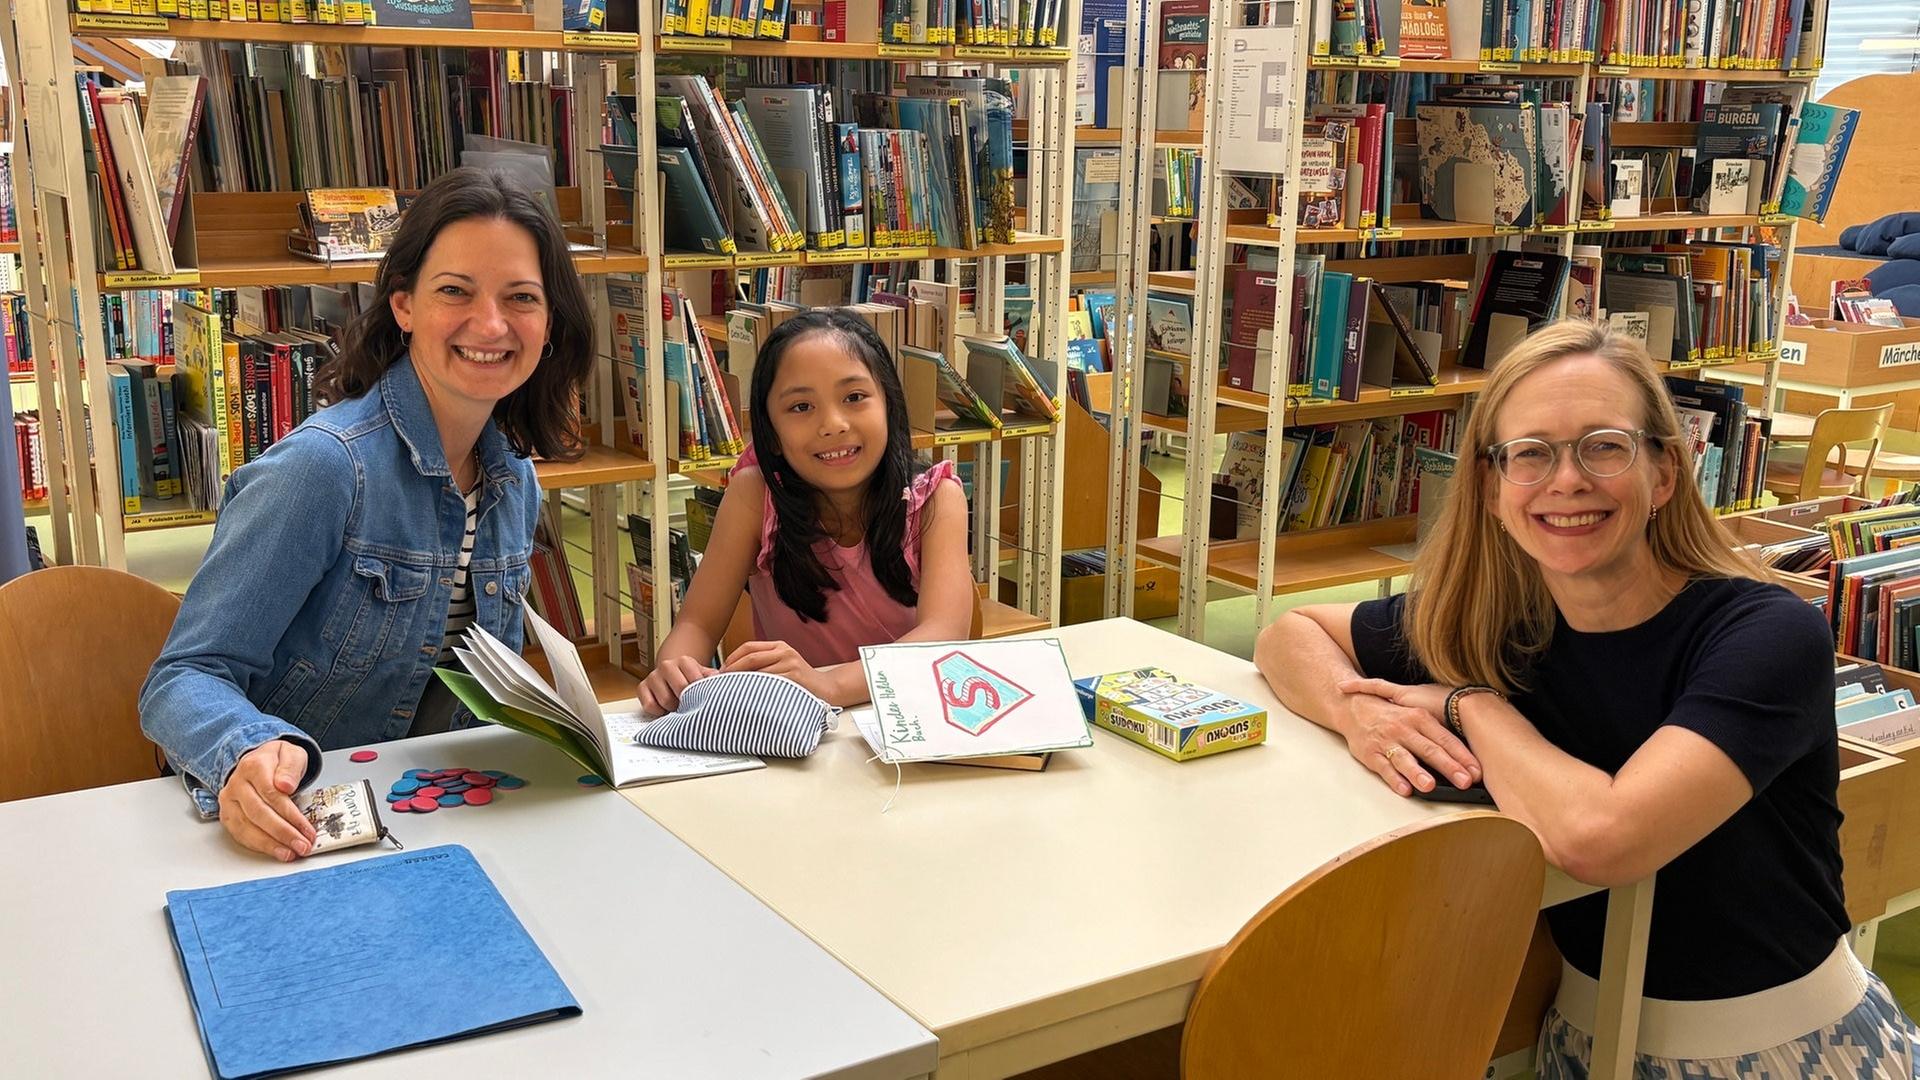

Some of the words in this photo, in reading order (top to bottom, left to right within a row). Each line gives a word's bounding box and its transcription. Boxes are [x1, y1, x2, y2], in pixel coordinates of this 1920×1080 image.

[1717, 112, 1761, 125] BURGEN
[823, 169, 831, 193] UNSERE
[831, 168, 839, 192] UNSERE
[1781, 347, 1801, 361] en
[244, 354, 255, 389] STORIES
[122, 385, 130, 404] euch!
[229, 392, 241, 415] KIDS
[244, 394, 259, 419] BOYS
[124, 405, 133, 439] Informiert
[875, 670, 896, 699] Helden
[1163, 699, 1240, 722] SUDOKU
[1898, 700, 1906, 709] C
[886, 701, 912, 744] Kinder
[1110, 714, 1145, 734] SUDOKU
[1206, 720, 1250, 743] SUDOKU
